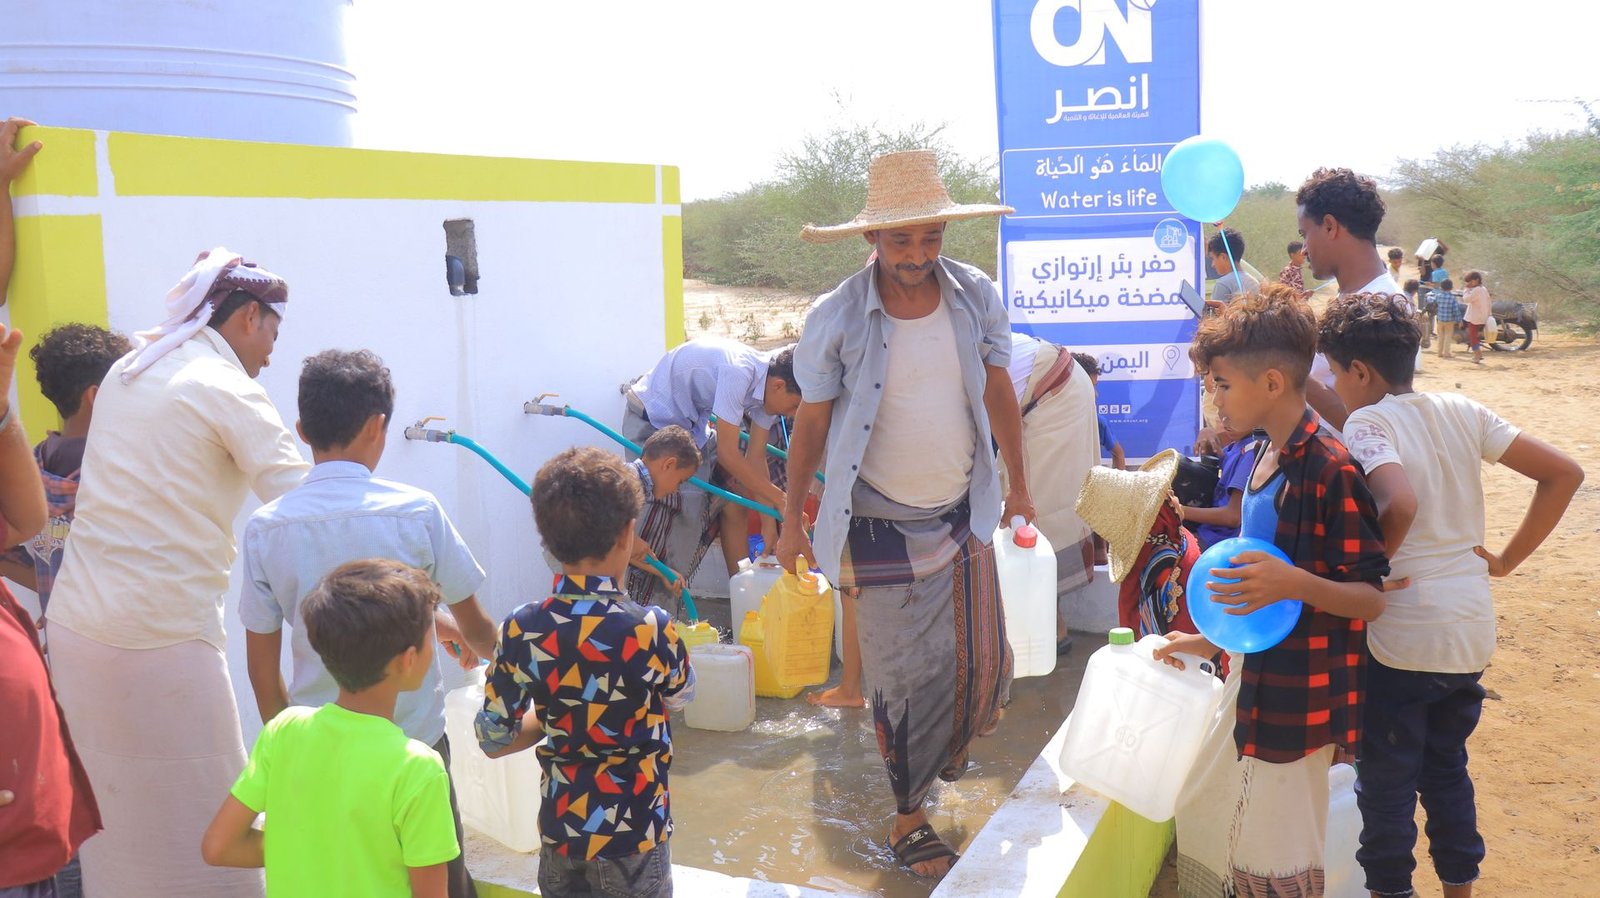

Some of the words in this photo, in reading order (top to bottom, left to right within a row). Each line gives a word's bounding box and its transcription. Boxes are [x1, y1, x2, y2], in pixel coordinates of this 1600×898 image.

[1045, 73, 1149, 125] انصر
[1040, 190, 1103, 209] Water
[1107, 190, 1122, 207] is
[1127, 187, 1157, 207] life
[1032, 254, 1102, 284] إرتوازي
[1108, 253, 1133, 280] بئر
[1139, 254, 1176, 279] حفر
[1013, 289, 1110, 314] ميكانيكية
[1101, 350, 1149, 374] اليمن
